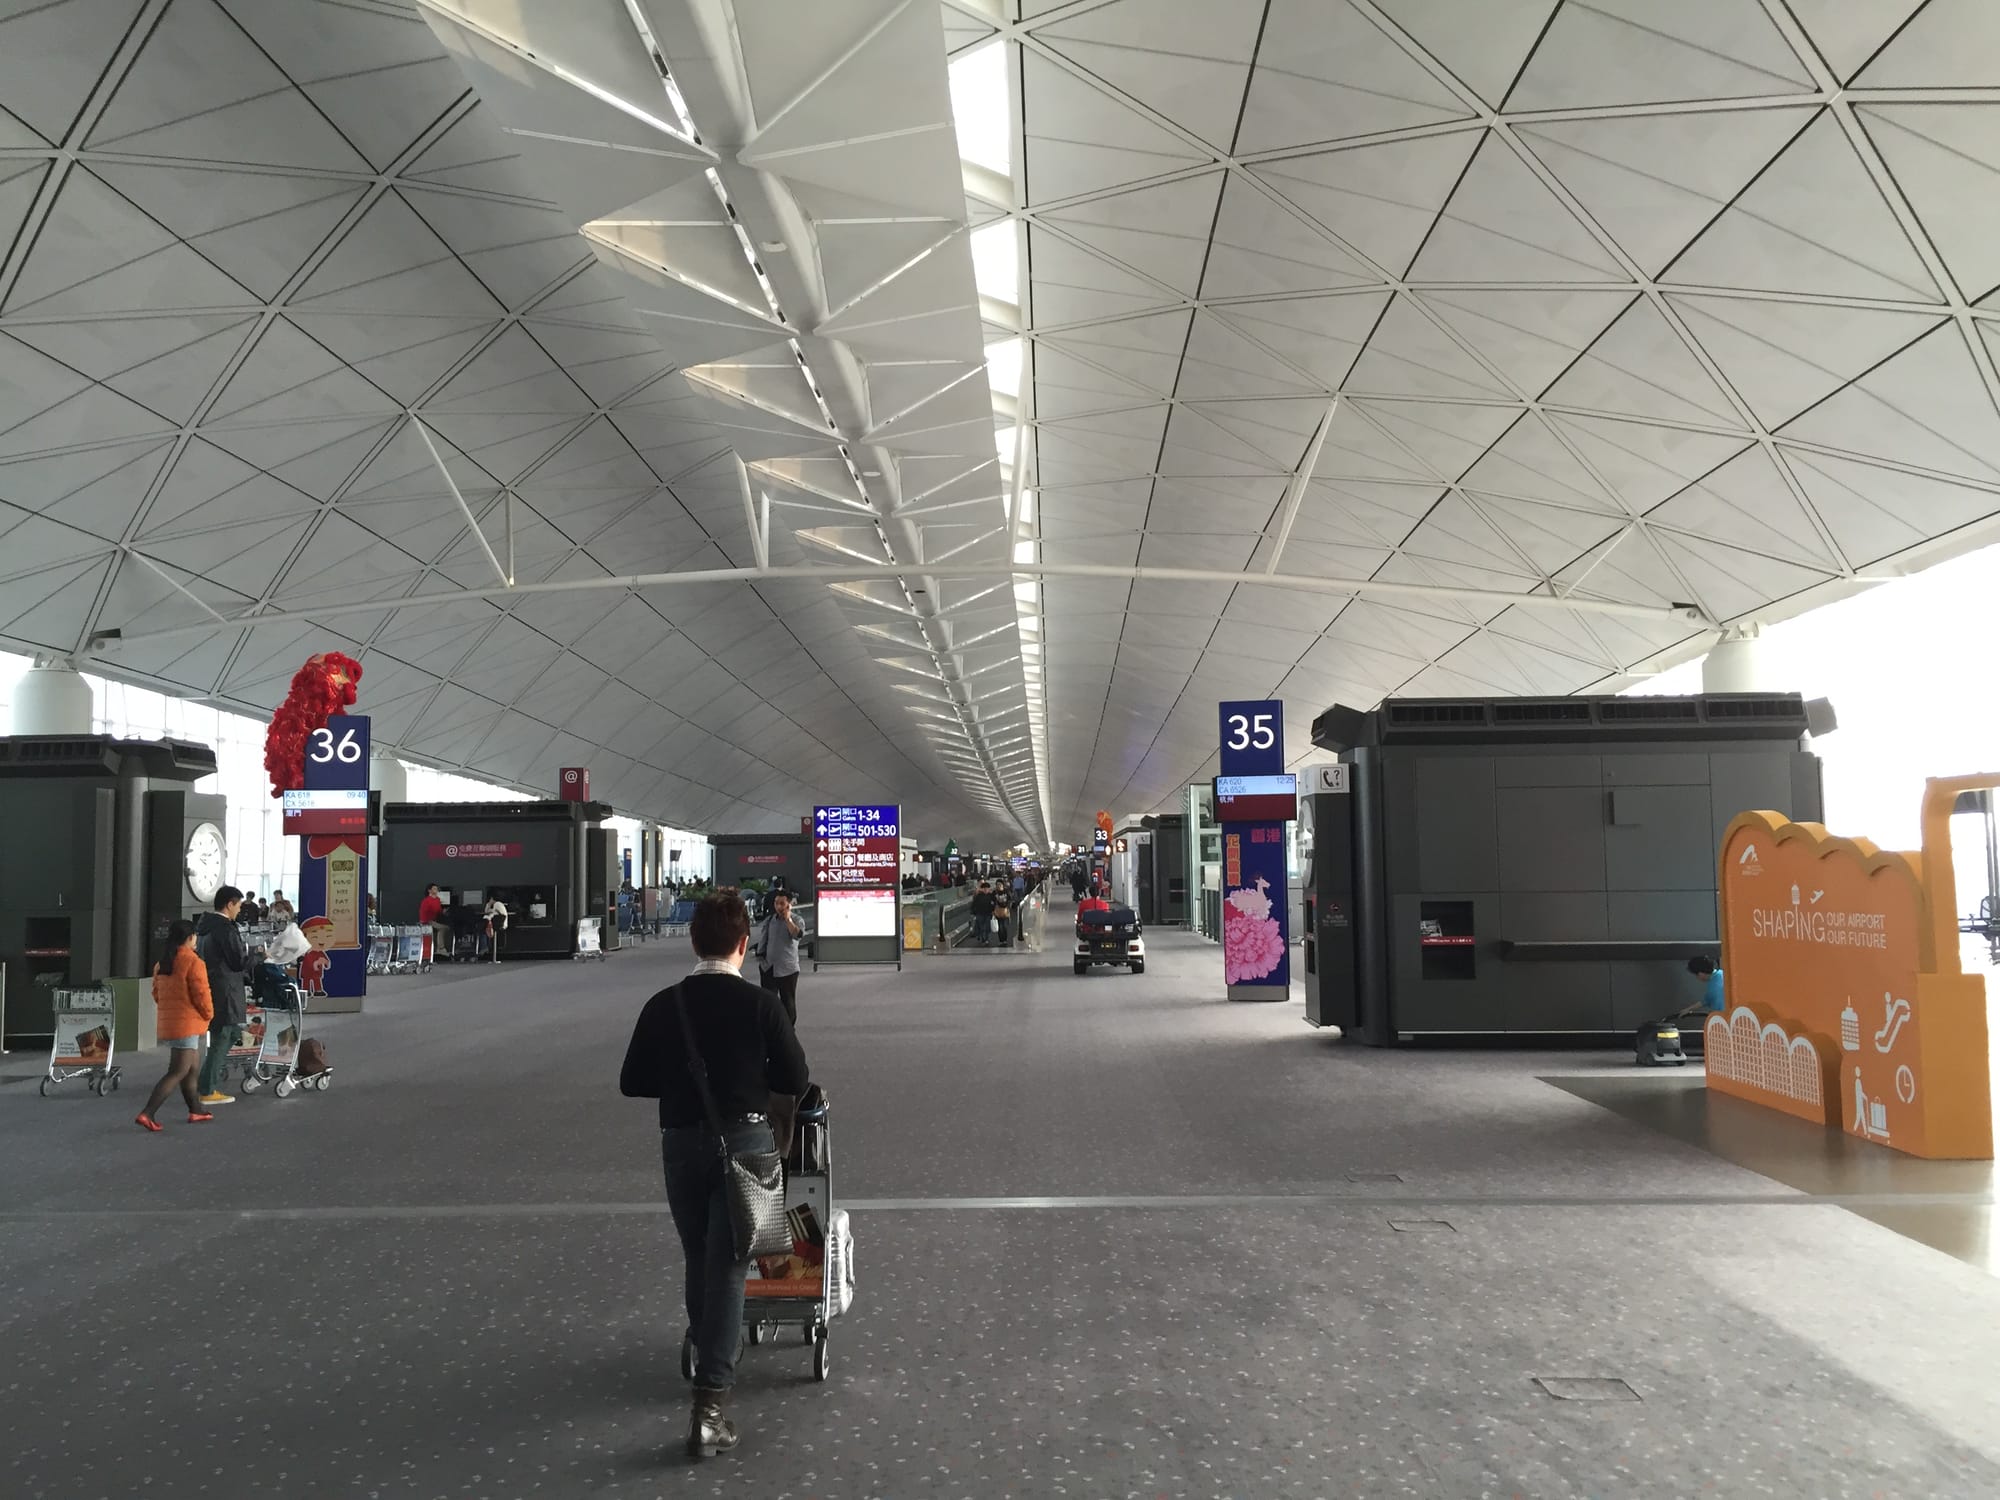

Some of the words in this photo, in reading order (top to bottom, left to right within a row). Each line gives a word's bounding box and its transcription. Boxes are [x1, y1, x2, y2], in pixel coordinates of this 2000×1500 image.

[1227, 714, 1275, 750] 35
[310, 728, 361, 763] 36
[1229, 777, 1242, 785] 620
[285, 791, 296, 799] KA
[297, 791, 311, 799] 618
[1218, 786, 1230, 794] CA
[858, 809, 880, 821] 1-34
[858, 825, 896, 836] 501-530
[1096, 830, 1108, 840] 33
[1752, 905, 1826, 943] SHAPING
[1826, 911, 1846, 927] OUR
[1848, 913, 1886, 930] AIRPORT
[1827, 929, 1846, 945] OUR
[1848, 931, 1887, 949] FUTURE
